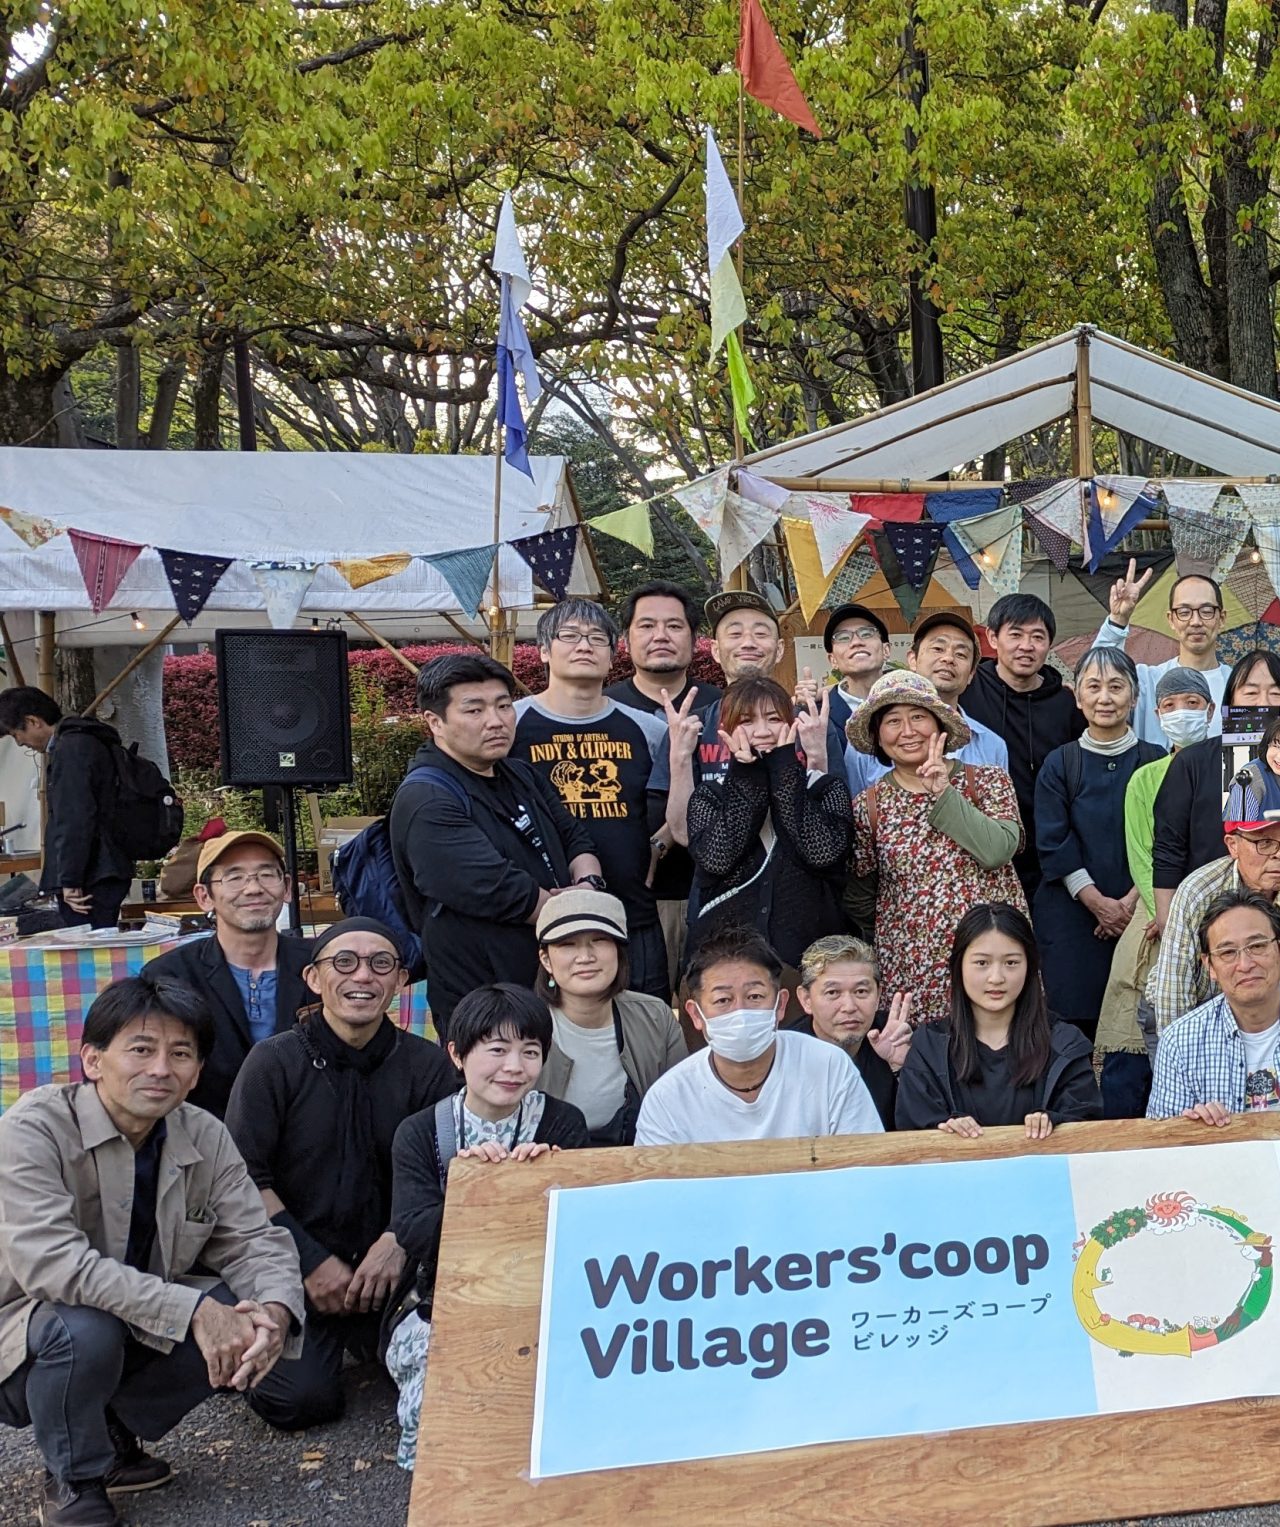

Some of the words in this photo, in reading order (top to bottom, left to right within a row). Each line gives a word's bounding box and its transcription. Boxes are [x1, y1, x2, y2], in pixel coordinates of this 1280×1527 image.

[529, 743, 562, 763] INDY
[566, 742, 578, 759] &
[580, 741, 632, 759] CLIPPER
[563, 802, 587, 818] VE
[591, 802, 628, 818] KILLS
[584, 1232, 1049, 1309] Workers'coop
[851, 1292, 1052, 1329] ワーカーズコープ
[580, 1317, 830, 1380] Village
[854, 1324, 949, 1351] ビレッジ
